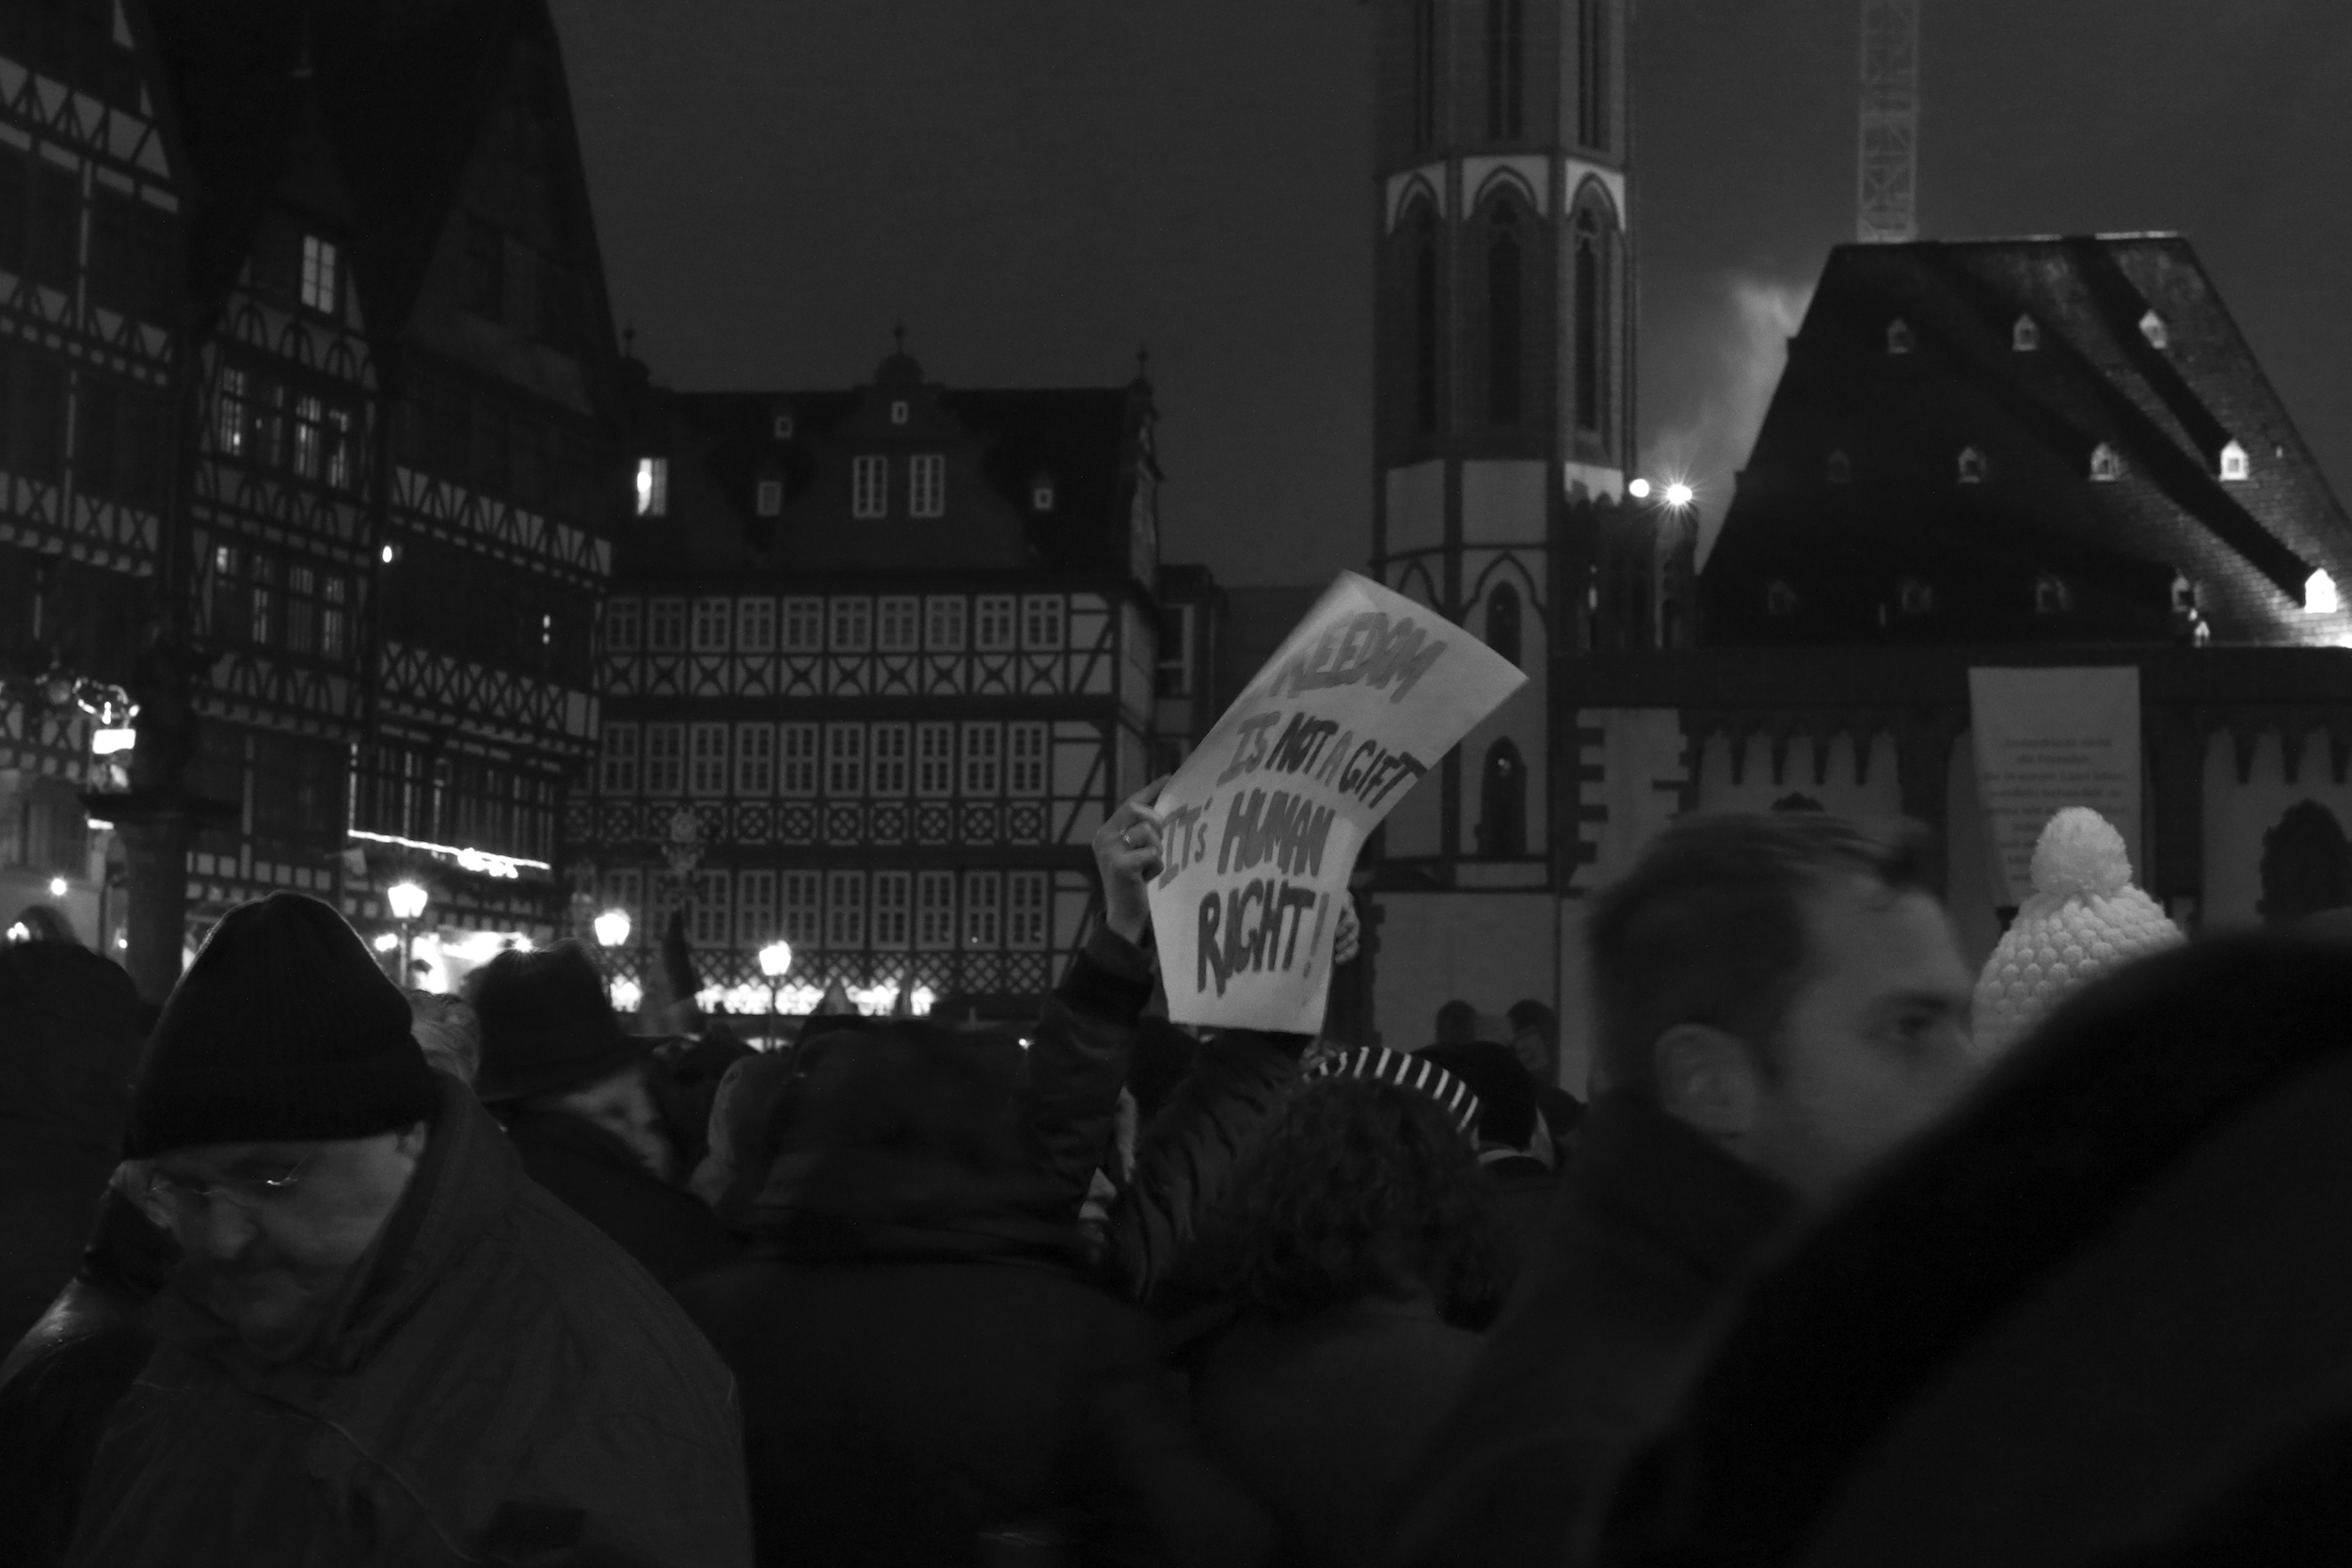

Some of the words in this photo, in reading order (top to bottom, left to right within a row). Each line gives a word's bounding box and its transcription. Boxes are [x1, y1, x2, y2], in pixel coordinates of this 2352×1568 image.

[1267, 611, 1449, 704] REEDOM
[1216, 710, 1282, 787] IS
[1264, 711, 1341, 776] NOT
[1315, 729, 1354, 788] A
[1338, 738, 1428, 810] GIFT
[1217, 787, 1337, 878] HUMAN
[1197, 879, 1330, 998] RIGHT!
